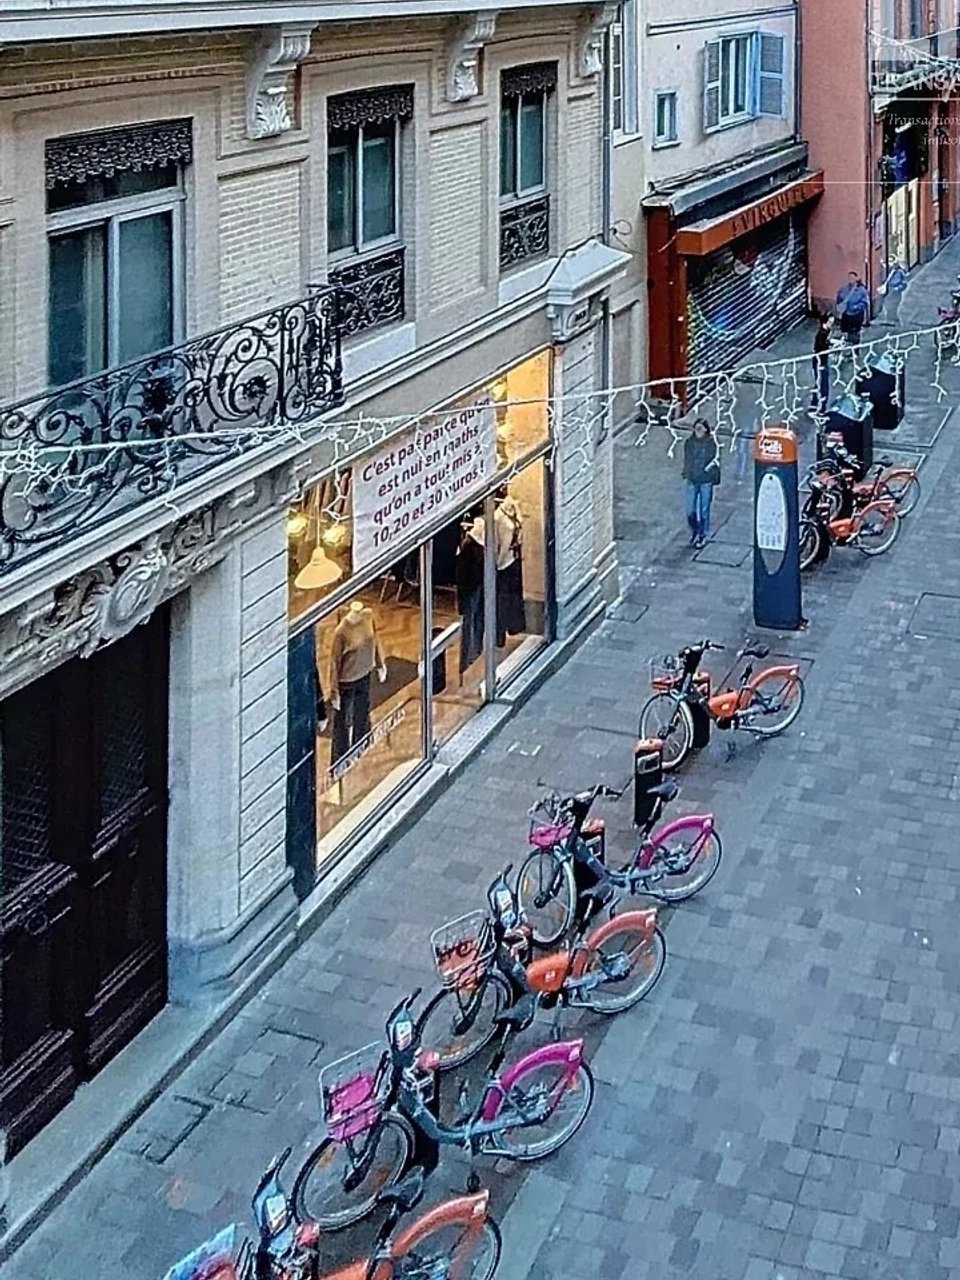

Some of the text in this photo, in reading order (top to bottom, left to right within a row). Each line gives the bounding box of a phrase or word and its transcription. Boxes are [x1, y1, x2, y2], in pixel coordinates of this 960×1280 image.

[362, 456, 397, 483] C'est
[398, 437, 422, 466] pas
[423, 416, 458, 451] parce
[378, 424, 479, 498] est nul en maths
[373, 491, 411, 526] qu'on
[414, 484, 422, 498] a
[424, 463, 450, 490] tout
[452, 446, 473, 473] mis
[373, 515, 411, 548] 10,20
[412, 503, 426, 520] et
[427, 488, 443, 511] 30
